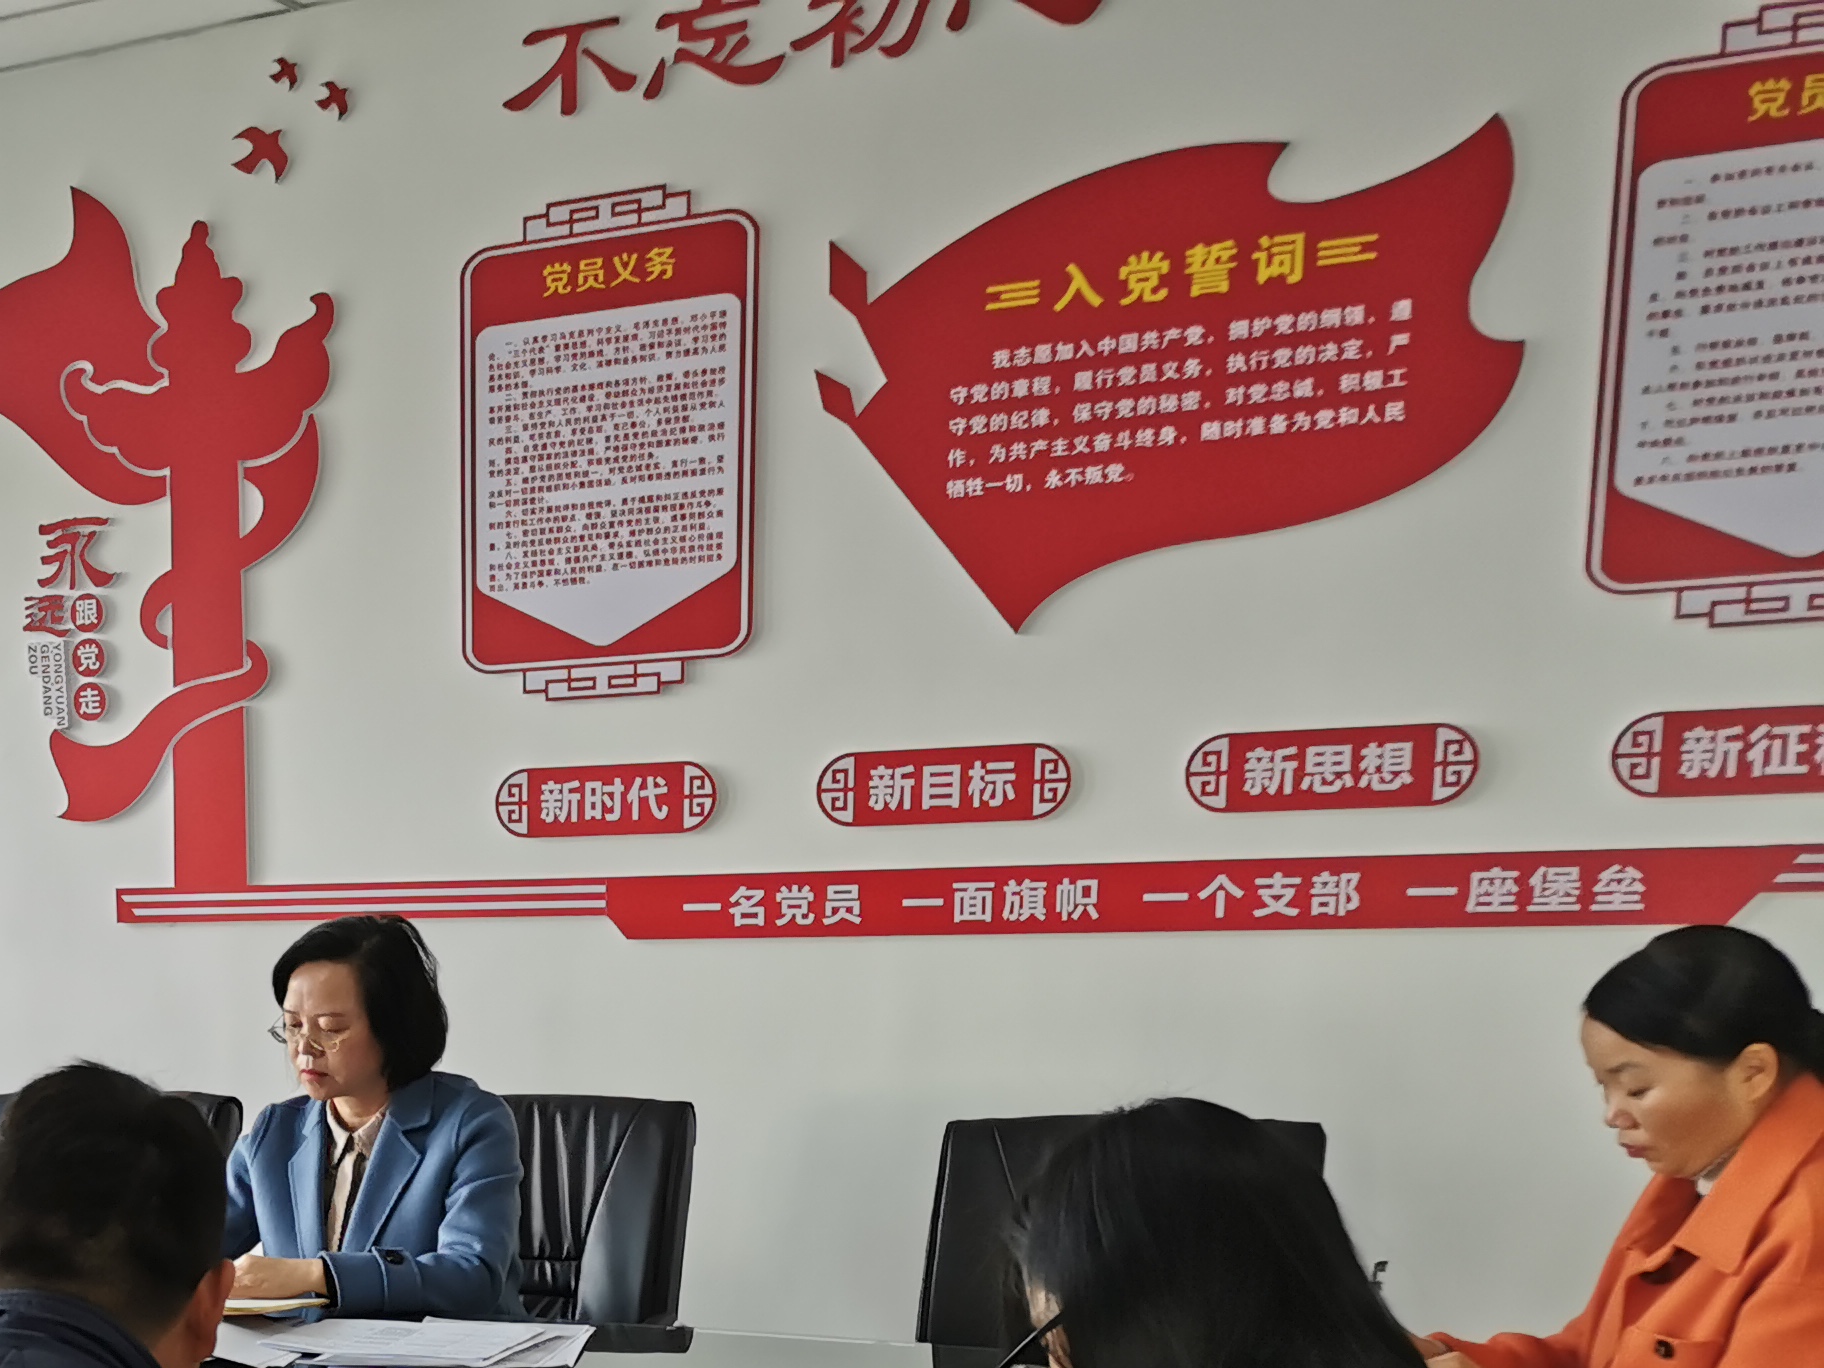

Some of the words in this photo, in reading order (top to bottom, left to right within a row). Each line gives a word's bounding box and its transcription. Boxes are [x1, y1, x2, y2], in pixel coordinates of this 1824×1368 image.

[502, 0, 1102, 117] 不忘初
[542, 247, 676, 297] 党员义务
[1053, 232, 1307, 313] 入党誓词
[27, 645, 38, 676] ZOU
[40, 644, 53, 717] GENDANG
[52, 643, 66, 727] YONGYUAN
[75, 598, 102, 716] 跟党走
[1241, 741, 1415, 797] 新思想
[1677, 723, 1824, 780] 新征
[539, 775, 670, 825] 新时代
[867, 760, 1017, 812] 新目标
[682, 883, 864, 928] 一名党员
[902, 878, 1100, 924] 一面旗帜
[1142, 870, 1363, 919] 一个支部
[1405, 863, 1647, 914] 一座堡垒
